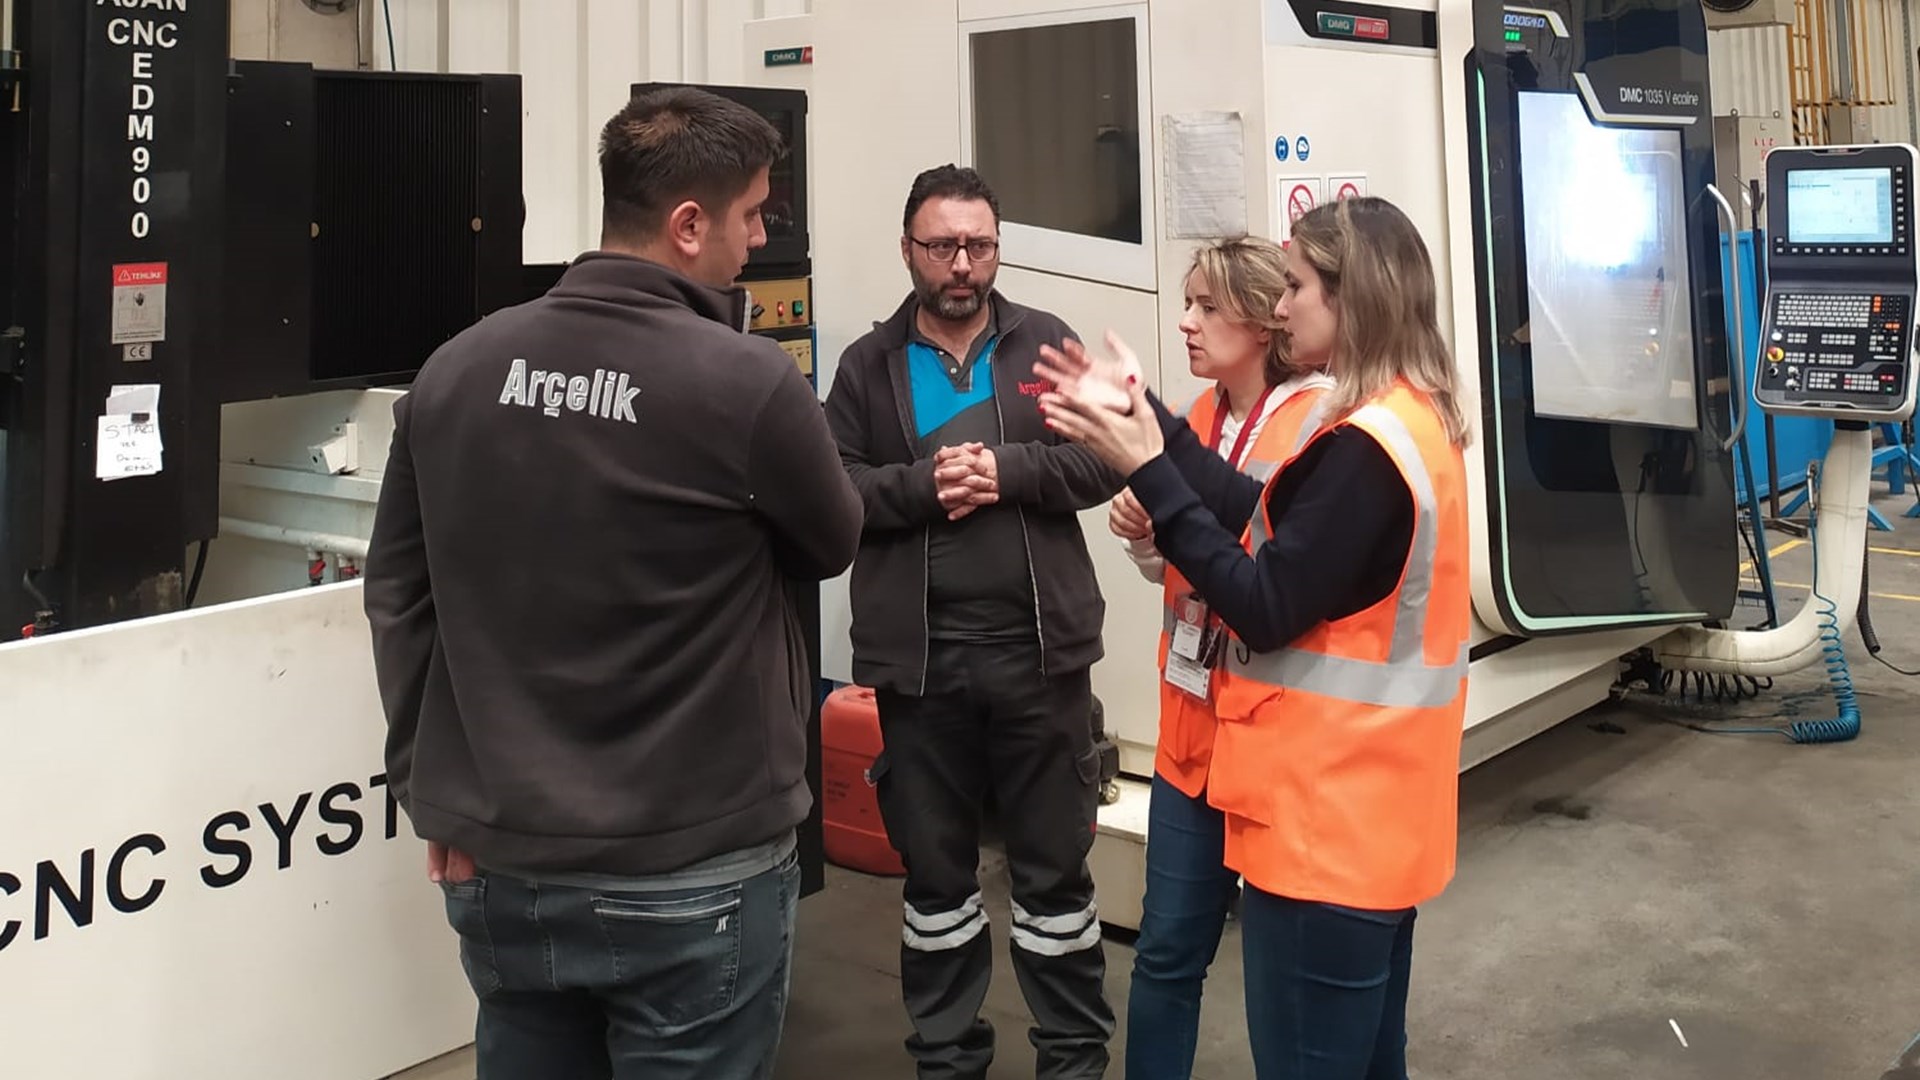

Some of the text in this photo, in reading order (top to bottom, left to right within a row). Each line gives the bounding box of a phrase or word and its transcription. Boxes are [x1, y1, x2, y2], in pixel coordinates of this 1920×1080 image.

[1327, 19, 1350, 30] DMG
[107, 18, 178, 48] CNC
[772, 52, 796, 61] DMG
[1619, 86, 1699, 106] DMC 1035 V ecoline
[129, 346, 146, 358] CE
[498, 358, 642, 423] Arçelik
